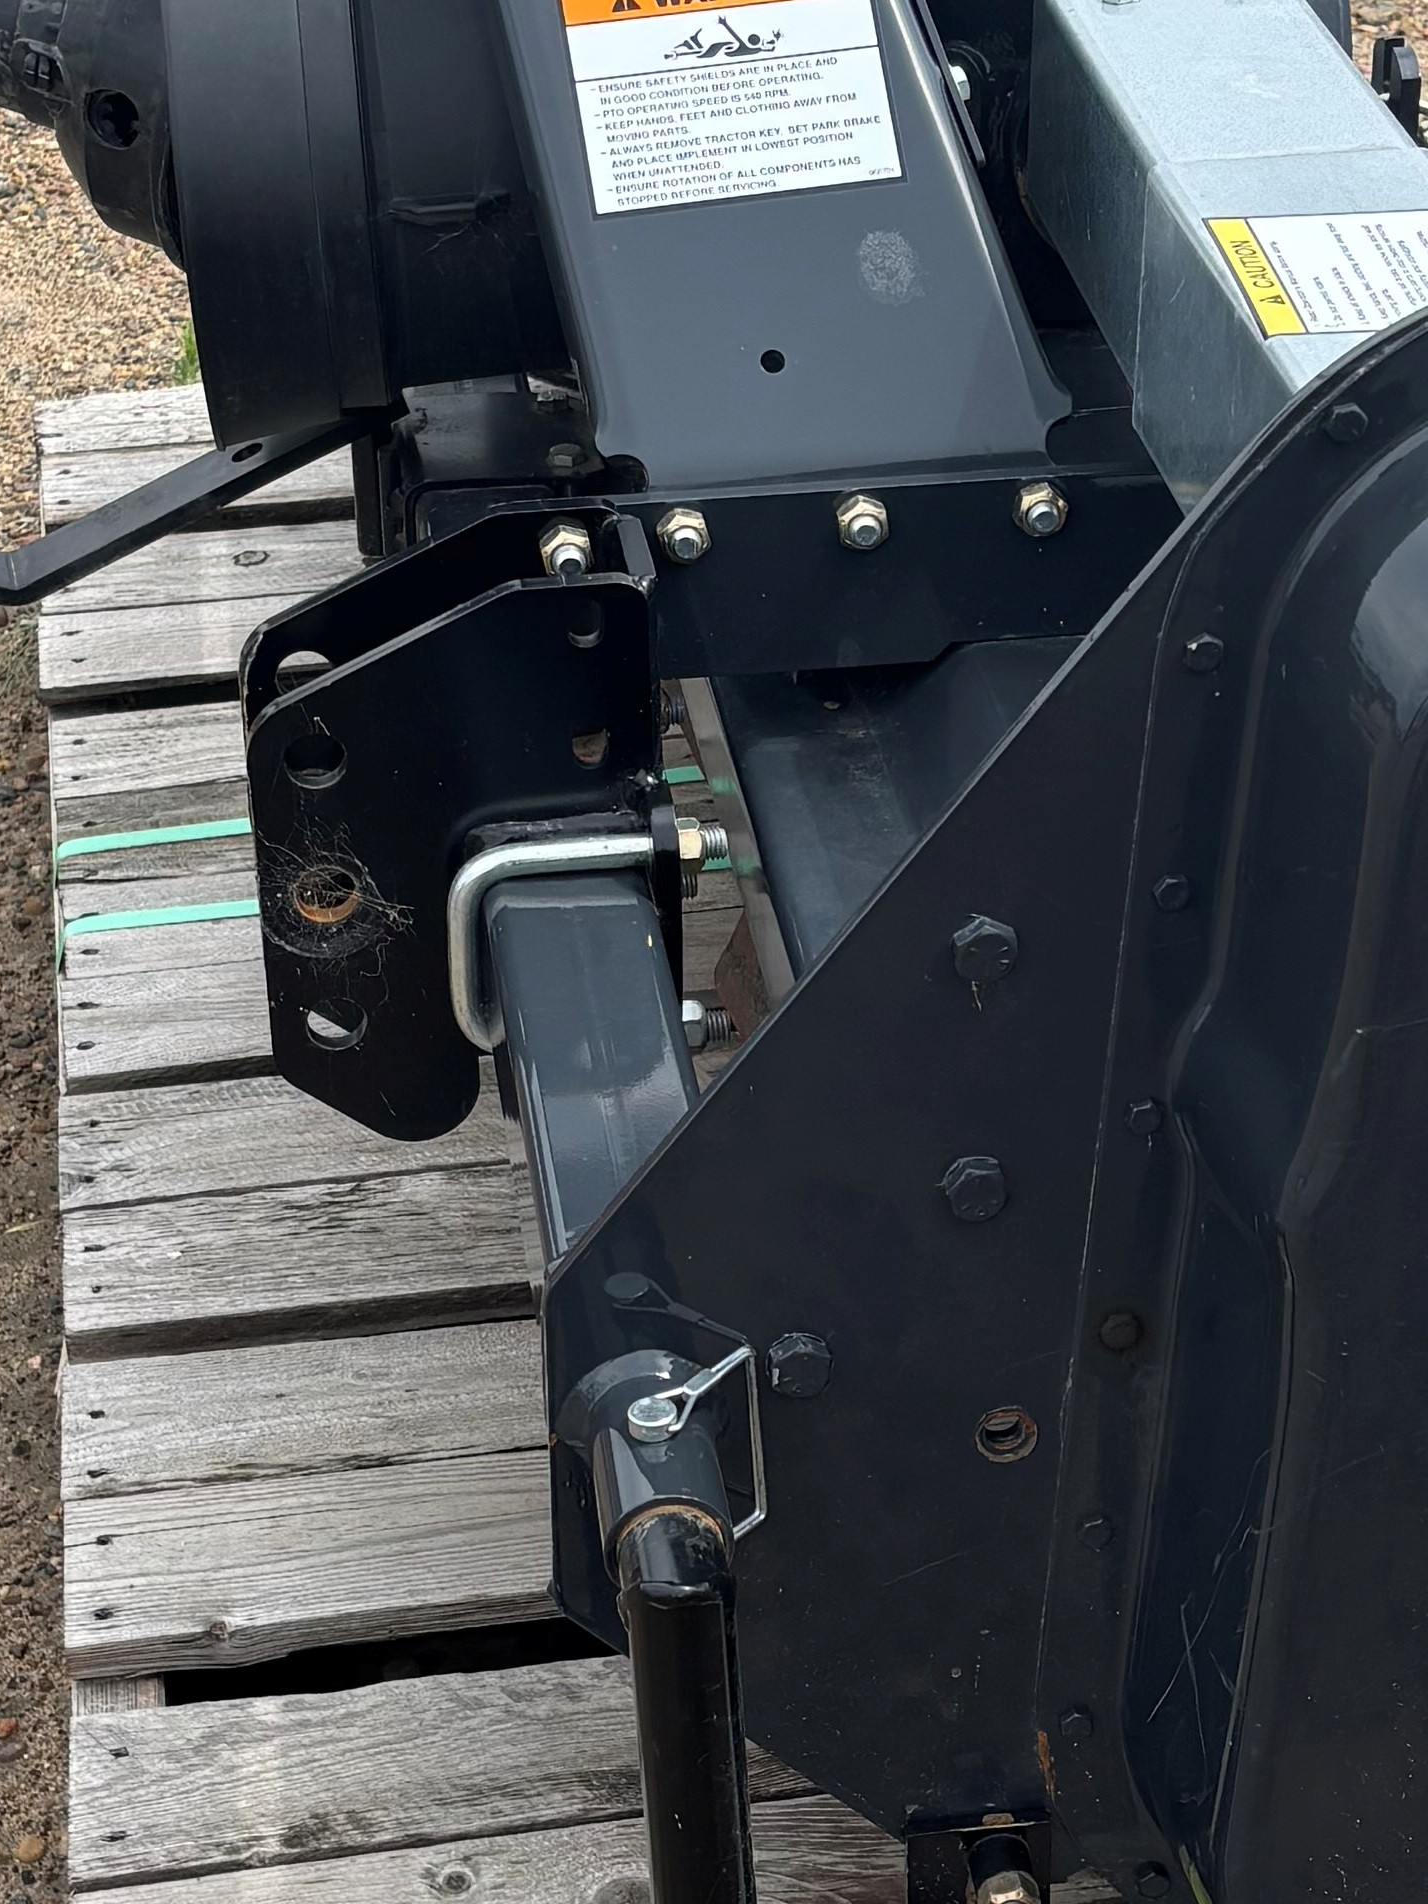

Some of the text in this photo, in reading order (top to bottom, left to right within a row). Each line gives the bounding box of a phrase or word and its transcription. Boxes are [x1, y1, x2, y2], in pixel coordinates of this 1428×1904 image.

[597, 56, 838, 94] ENSURE SAFETY SHIELDS ARE IN PLACE AND
[599, 95, 611, 107] IN
[612, 91, 647, 105] GOOD
[647, 84, 709, 101] CONDITION
[710, 78, 755, 93] BEFORE
[601, 107, 625, 119] PTO
[625, 99, 689, 116] OPERATING
[691, 94, 729, 108] SPEED
[729, 93, 742, 103] IS
[743, 90, 762, 102] 540
[603, 119, 634, 132] KEEP
[678, 110, 707, 123] FEET
[708, 107, 733, 119] AND
[734, 100, 791, 116] CLOTHING
[792, 96, 823, 109] AWAY
[824, 92, 857, 105] FROM
[605, 130, 650, 144] MOVING
[608, 142, 653, 157] ALWAYS
[654, 136, 702, 151] REMOVE
[703, 129, 756, 145] TRACTOR
[787, 123, 809, 135] SET
[810, 119, 841, 132] PARK
[842, 114, 881, 128] BRAKE
[610, 130, 853, 169] AND PLACE IMPLEMENT IN LOWEST POSITION
[612, 169, 646, 182] WHEN
[614, 155, 861, 194] ENSURE ROTATION OF ALL COMPONENTS HAS
[616, 192, 668, 207] STOPPED
[670, 186, 715, 200] BEFORE
[1230, 239, 1275, 290] CAUTION
